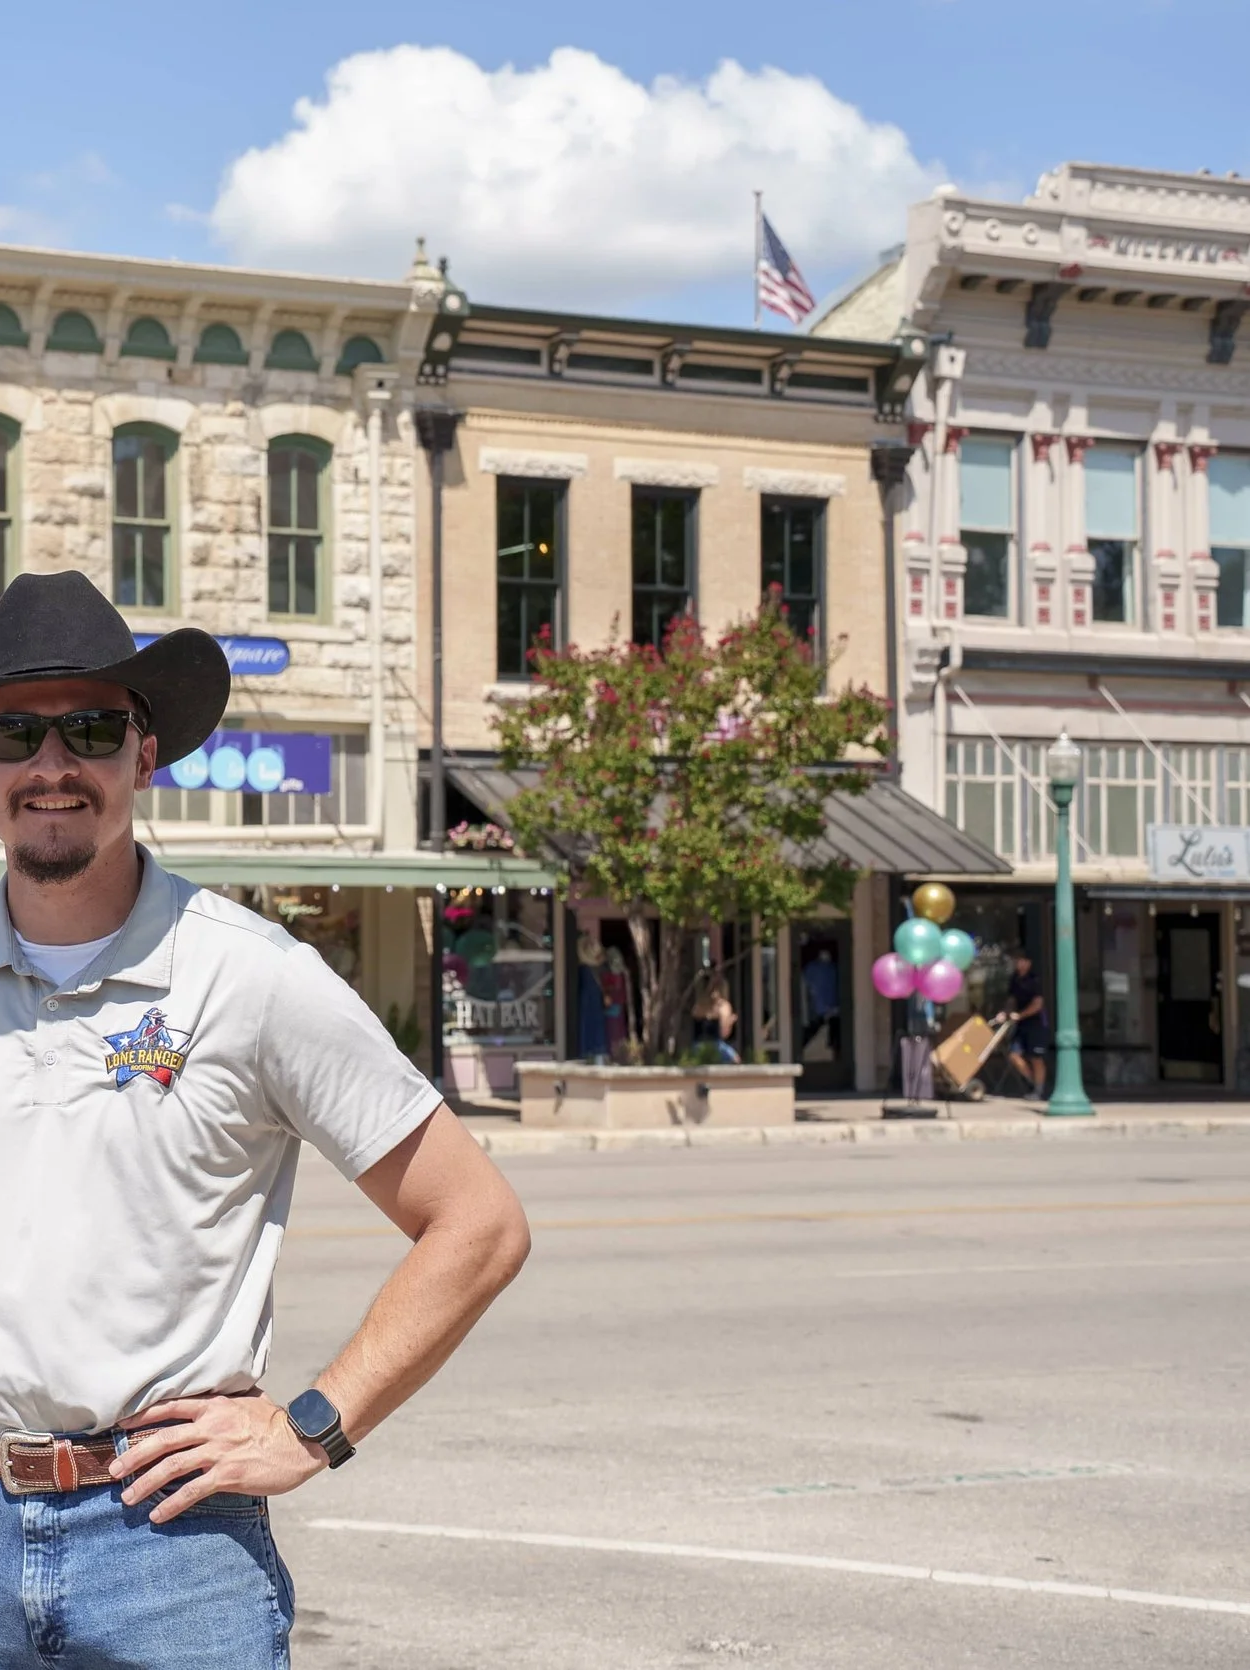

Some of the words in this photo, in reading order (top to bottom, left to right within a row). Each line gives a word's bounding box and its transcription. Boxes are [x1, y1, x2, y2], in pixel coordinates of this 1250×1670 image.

[455, 1000, 496, 1028] HAT
[500, 1000, 540, 1028] BAR
[107, 1050, 136, 1069] LONE
